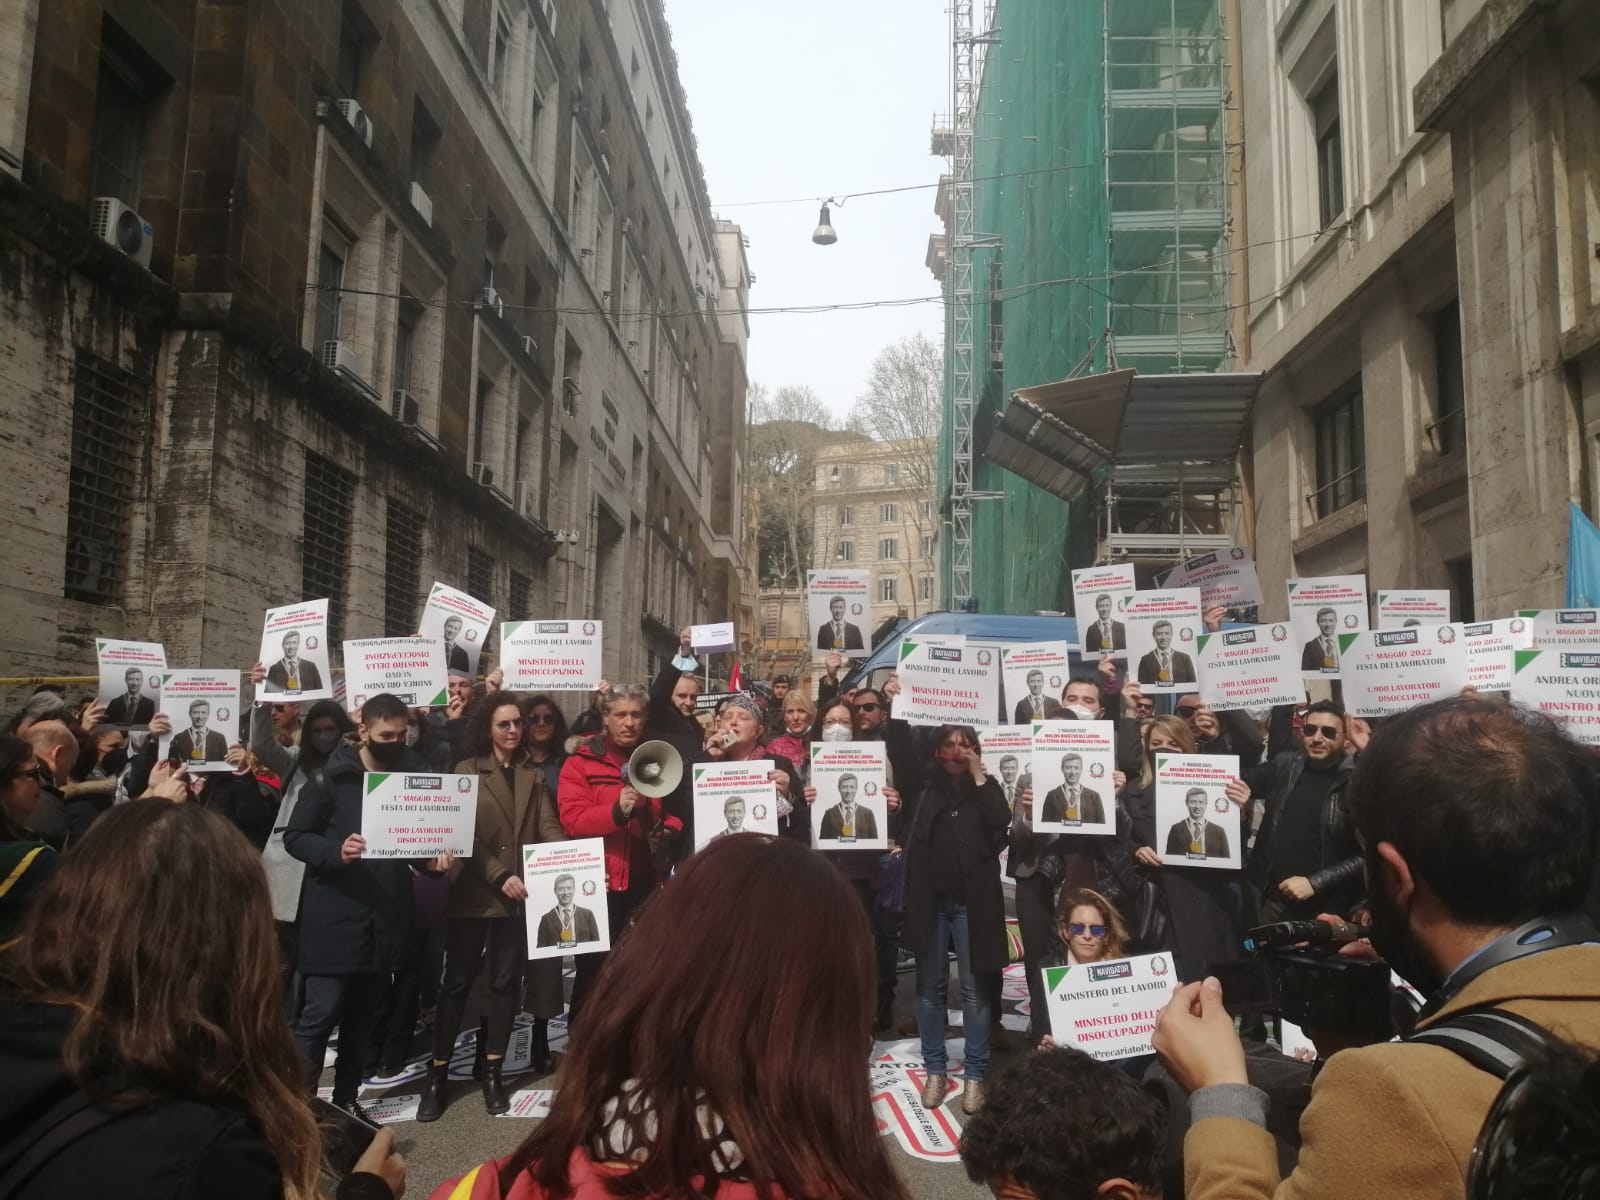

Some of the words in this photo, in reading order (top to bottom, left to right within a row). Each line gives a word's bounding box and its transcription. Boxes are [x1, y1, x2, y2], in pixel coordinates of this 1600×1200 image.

[1203, 569, 1240, 581] LAVORATORI
[541, 624, 567, 632] NAVIGATOR
[565, 638, 592, 646] LAVORO
[1228, 632, 1254, 642] NAVIGATOR
[1382, 632, 1416, 642] NAVIGATOR
[1224, 649, 1249, 658] MAGGIO
[1376, 652, 1407, 660] MAGGIO
[1410, 649, 1432, 658] 2022
[1470, 645, 1513, 654] LAVORATORI
[365, 651, 429, 660] DISOCCUPAZIONE
[366, 662, 390, 670] DELLA
[392, 661, 429, 669] MINISTRO
[518, 658, 560, 666] MINISTERO
[562, 658, 585, 666] DELLA
[1208, 661, 1226, 669] FESTA
[1227, 659, 1238, 667] DEI
[1239, 655, 1280, 665] LAVORATORI
[1356, 663, 1378, 672] FESTA
[1380, 662, 1393, 670] DEI
[1394, 658, 1446, 669] LAVORATORI
[518, 668, 584, 676] DISOCCUPAZIONE
[905, 664, 940, 674] MINISTERO
[942, 666, 956, 675] DEL
[958, 668, 987, 676] LAVORO
[404, 680, 432, 688] ANDREA
[1236, 677, 1278, 686] LAVORATORI
[1535, 676, 1579, 684] ANDREA
[508, 682, 594, 690] #StopPrecariatoPubblico
[1366, 685, 1390, 693] 1.900
[1391, 682, 1440, 692] LAVORATORI
[912, 686, 952, 697] MINISTERO
[954, 690, 979, 699] DELLA
[1226, 687, 1270, 697] DISOCCUPATI
[1378, 693, 1430, 702] DISOCCUPATI
[912, 697, 978, 710] DISOCCUPAZIONE
[1540, 702, 1593, 711] MINISTRO
[901, 711, 989, 725] #StopPrecariatoPubblico
[412, 778, 440, 786] NAVIGATOR
[1097, 965, 1129, 977] NAVIGATOR
[1060, 988, 1108, 1002] MINISTERO
[1111, 986, 1129, 996] DEL
[1131, 981, 1167, 993] LAVORO
[1074, 1014, 1128, 1029] MINISTERO
[1131, 1009, 1161, 1021] DELLA
[1078, 1024, 1156, 1042] DISOCCUPAZION
[913, 1108, 929, 1126] DELLE
